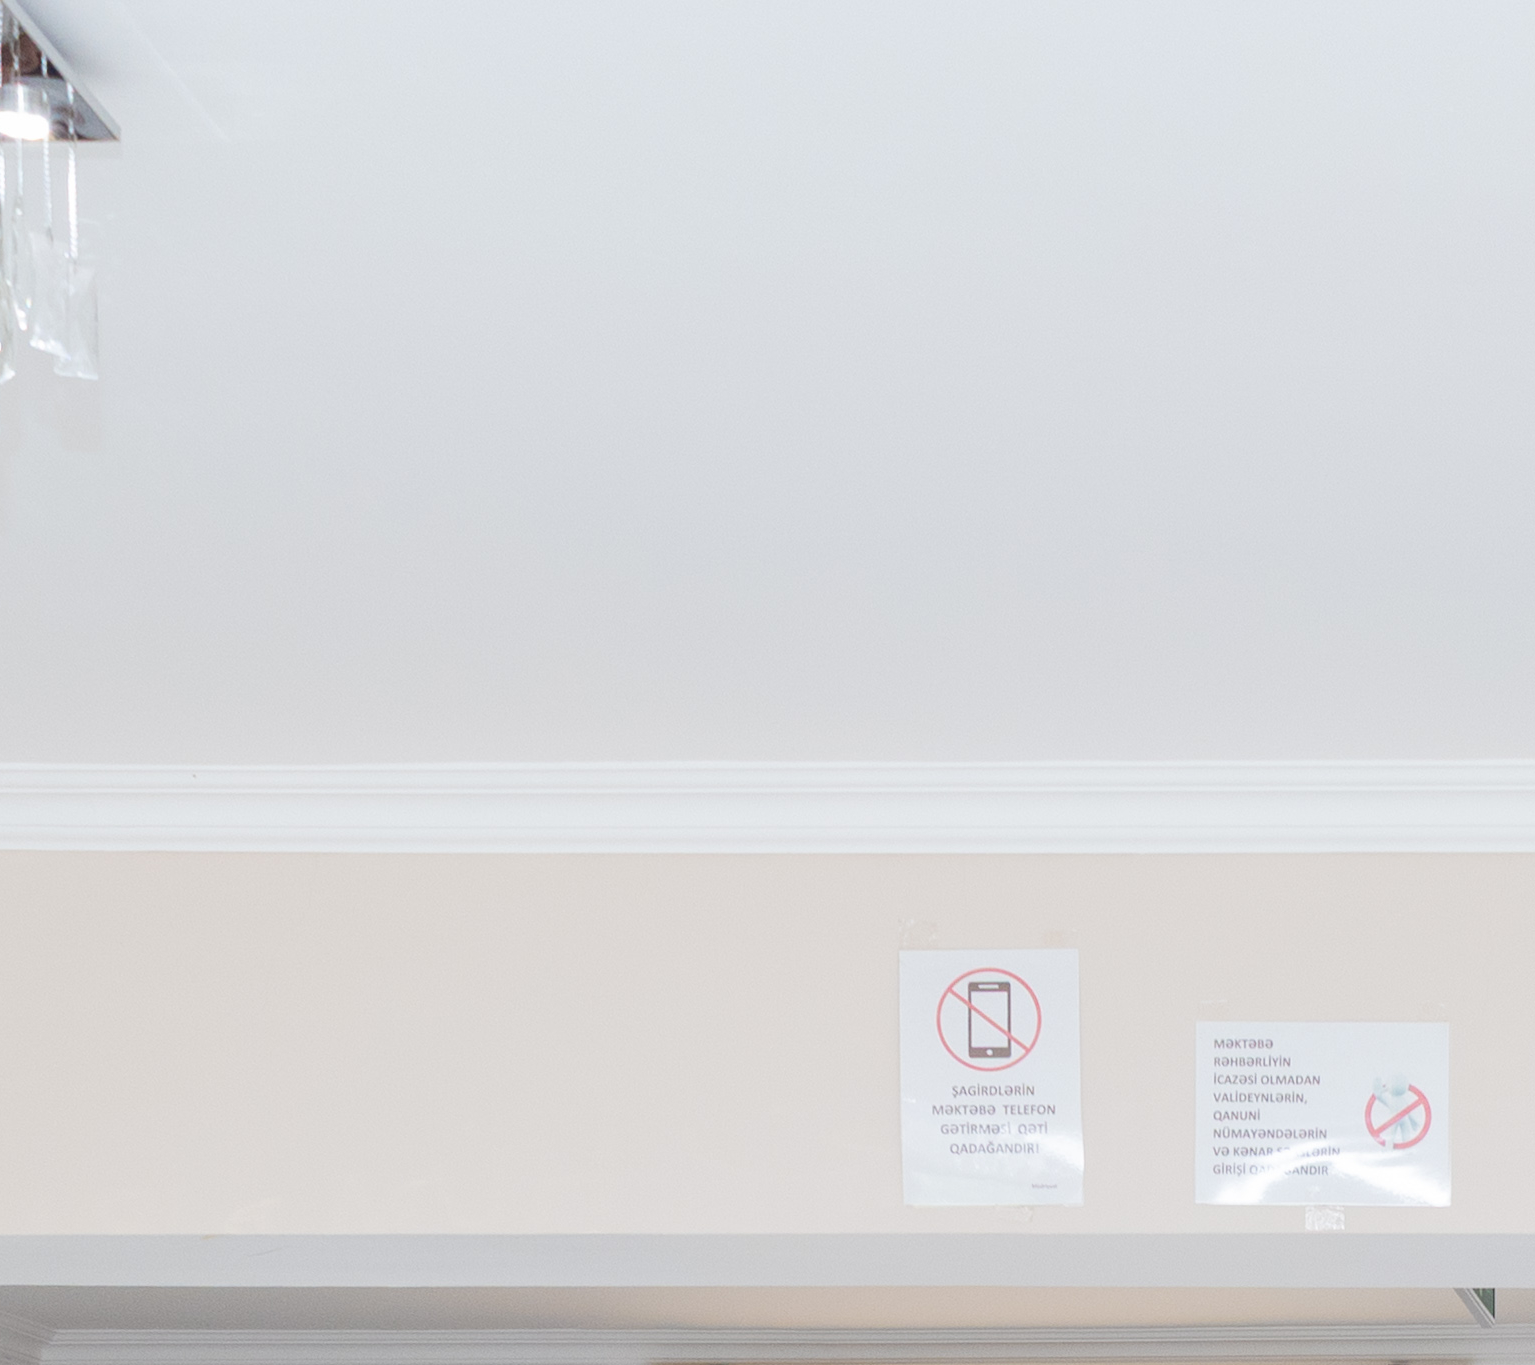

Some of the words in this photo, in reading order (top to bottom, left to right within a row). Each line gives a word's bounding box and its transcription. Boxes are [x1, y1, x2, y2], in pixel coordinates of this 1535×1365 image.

[1214, 1038, 1274, 1049] MƏKTƏBƏ
[1214, 1055, 1291, 1067] RƏHBƏRLİYİN
[1214, 1073, 1257, 1085] İCAZƏSİ
[1261, 1074, 1321, 1085] OLMADAN
[952, 1083, 1035, 1099] ŞAGİRDLƏRİN
[1213, 1090, 1308, 1104] VALİDEYNLƏRİN,
[932, 1104, 996, 1115] MƏKTƏBƏ
[1003, 1104, 1056, 1115] TELEFON
[1213, 1109, 1261, 1121] QANUNİ
[1018, 1121, 1048, 1135] QƏTİ
[1213, 1127, 1328, 1140] NÜMAYƏNDƏLƏRİN
[950, 1141, 1040, 1155] QADAĞANDIR!
[1213, 1146, 1230, 1156] VƏ
[1233, 1146, 1273, 1156] KƏNAR
[1213, 1163, 1246, 1177] GİRİŞİ
